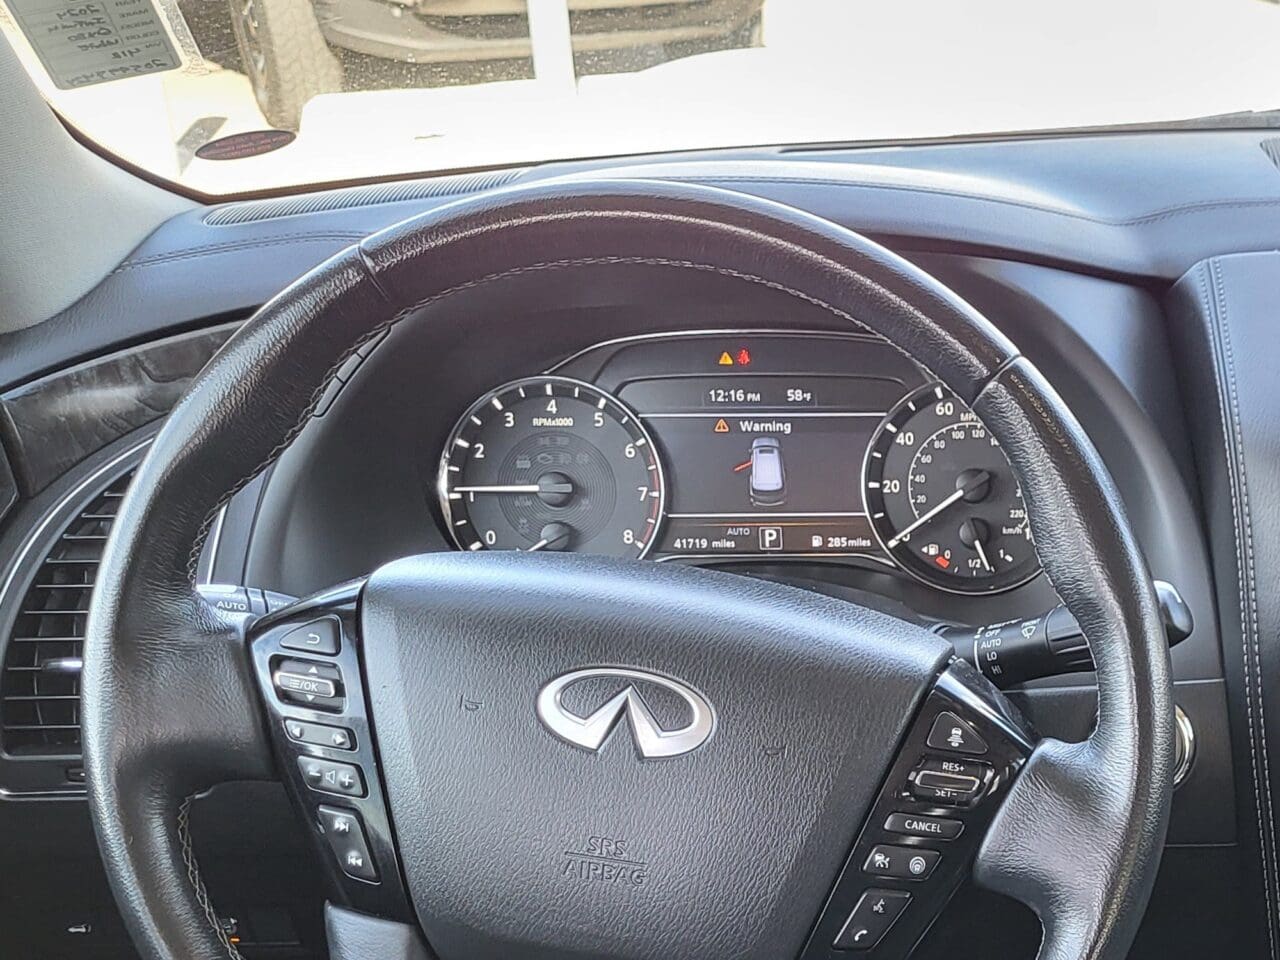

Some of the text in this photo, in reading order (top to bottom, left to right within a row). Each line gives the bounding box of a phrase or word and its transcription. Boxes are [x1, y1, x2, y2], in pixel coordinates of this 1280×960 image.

[709, 389, 745, 402] 12:16
[747, 393, 760, 402] PM
[546, 399, 557, 414] 4
[935, 402, 954, 415] 60
[504, 412, 514, 427] 3
[594, 412, 604, 427] 5
[740, 421, 792, 433] Warning
[896, 433, 914, 445] 40
[952, 430, 965, 440] 100
[934, 440, 946, 449] 80
[474, 444, 485, 458] 2
[625, 444, 635, 458] 6
[921, 455, 932, 463] 60
[914, 475, 926, 483] 40
[883, 480, 900, 493] 20
[637, 487, 647, 501] 7
[916, 495, 927, 503] 20
[486, 530, 496, 544] 0
[623, 530, 633, 544] 8
[727, 528, 750, 536] AUTO
[673, 539, 735, 549] 41719 miles
[764, 530, 777, 547] P
[828, 536, 871, 547] 285 miles
[216, 600, 247, 611] AUTO
[981, 638, 1002, 649] AUTO
[986, 651, 998, 661] LO
[991, 665, 1003, 675] HI
[942, 761, 965, 771] RES+
[904, 819, 942, 833] CANCEL
[587, 835, 628, 858] SRS
[562, 859, 647, 887] AIRBAG
